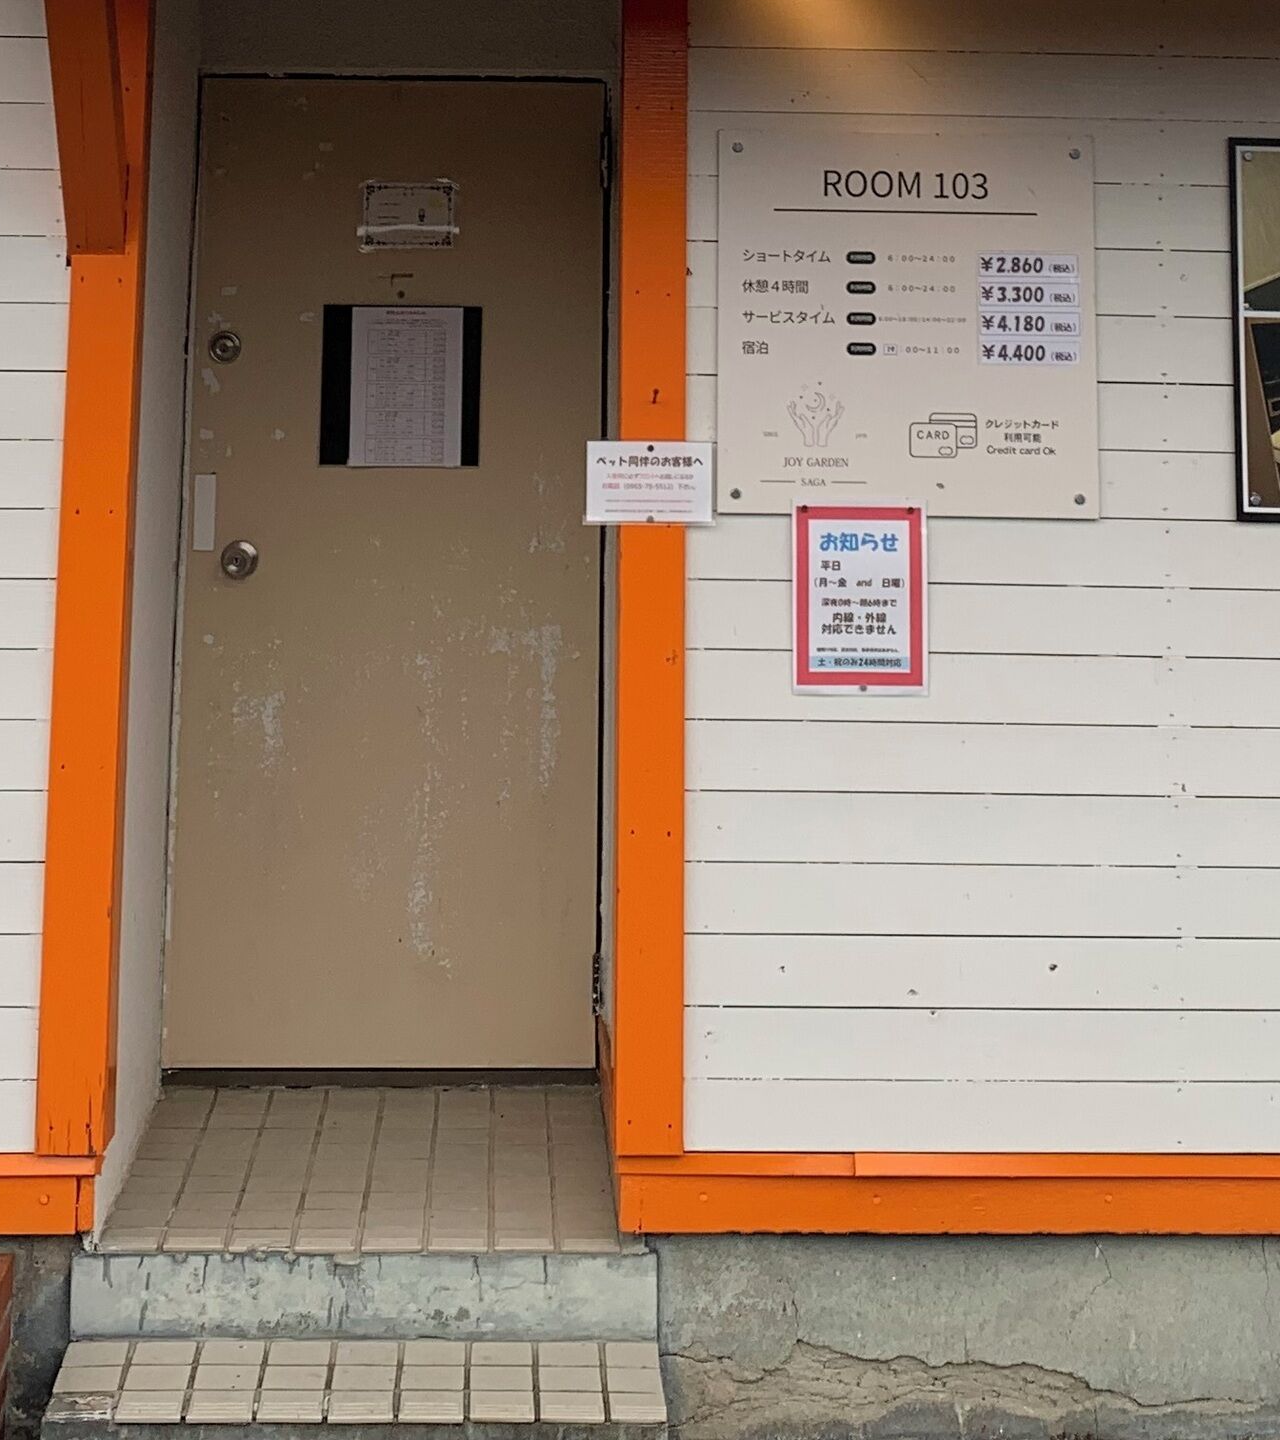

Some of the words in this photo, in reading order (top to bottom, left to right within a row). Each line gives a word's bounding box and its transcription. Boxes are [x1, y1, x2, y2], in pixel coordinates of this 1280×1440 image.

[823, 169, 921, 199] ROOM
[933, 172, 989, 200] 103
[742, 248, 831, 264] ショートタイム
[742, 279, 809, 295] 休憩4時間
[741, 310, 836, 325] サービスタイム
[742, 340, 769, 356] 宿泊
[985, 419, 1060, 430] クレジットカード
[916, 430, 950, 441] CARD
[1004, 432, 1042, 443] 利用可能
[986, 444, 1017, 455] Credit
[1019, 445, 1041, 456] card
[596, 455, 704, 468] ペット同伴のお客様へ
[783, 456, 804, 468] JOY
[806, 457, 850, 468] GARDEN
[800, 477, 827, 487] SAGA
[819, 531, 900, 553] お知らせ
[820, 559, 842, 572] 平日
[855, 578, 873, 588] and
[832, 611, 887, 624] 内線・外線
[821, 623, 898, 636] 対応できません
